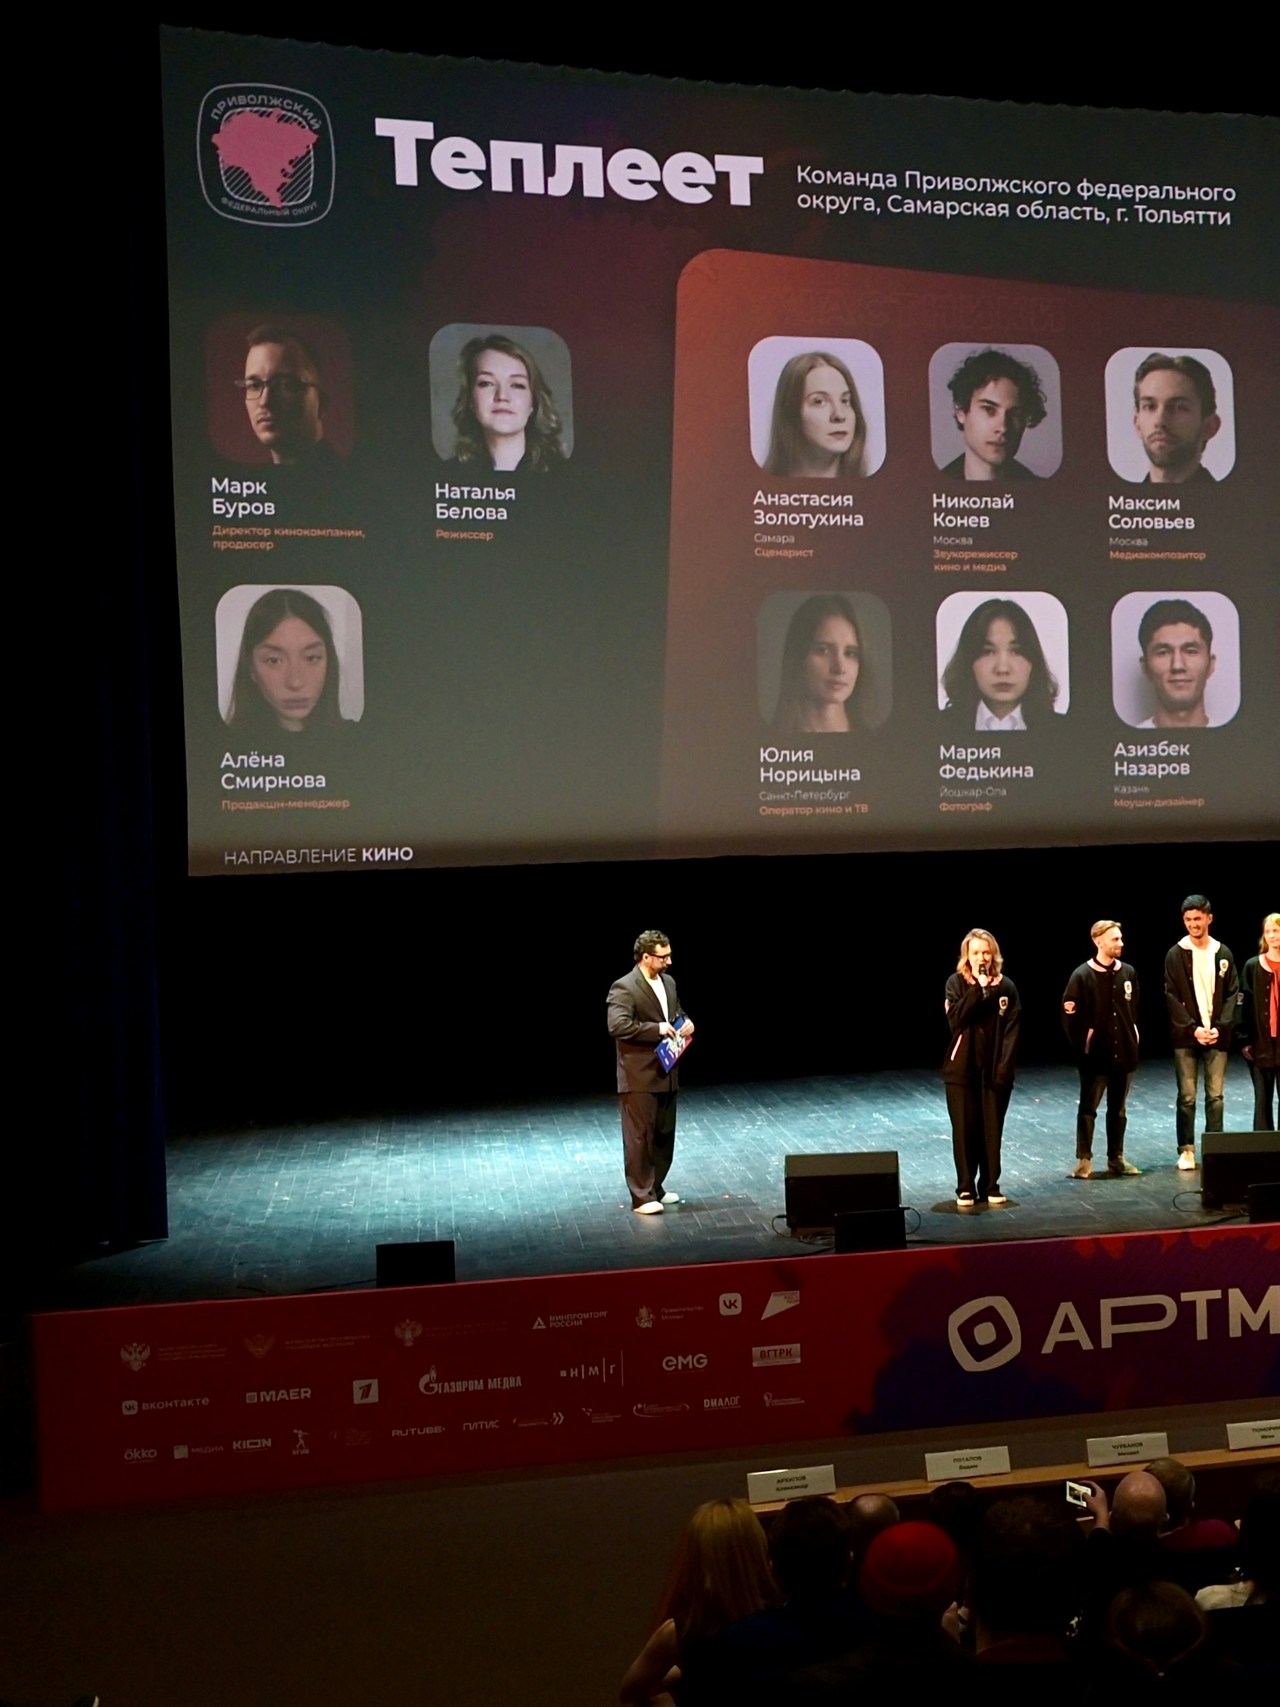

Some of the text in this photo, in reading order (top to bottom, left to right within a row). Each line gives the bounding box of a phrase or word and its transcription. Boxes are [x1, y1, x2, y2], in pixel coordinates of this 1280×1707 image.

[211, 94, 321, 130] ПРИВОЛЖСКИЙ
[375, 117, 764, 206] Теплеет
[797, 166, 1236, 202] Команда Приволжского федерального
[221, 196, 318, 216] ФЕДЕРАЛЬНЫЙ ОКРУГ
[797, 192, 1231, 226] округа, Самарская область, г. Тольятти
[211, 478, 267, 497] Марк
[435, 483, 516, 501] Наталья
[753, 490, 854, 507] Анастасия
[932, 493, 1015, 509] Николай
[1108, 495, 1181, 511] Максим
[212, 498, 276, 518] Буров
[436, 503, 508, 520] Белова
[754, 510, 864, 529] Золотухина
[933, 513, 990, 528] Конев
[1108, 514, 1196, 530] Соловьев
[212, 525, 366, 540] Директор кинокомпании,
[436, 529, 494, 542] Режиссер
[754, 533, 795, 545] Самара
[933, 535, 973, 546] Москва
[213, 539, 274, 552] продюсер
[1109, 537, 1149, 547] Москва
[754, 547, 814, 559] Сценарист
[933, 549, 1018, 561] Звукорежиссер
[1109, 550, 1207, 561] Медиакомпозитор
[934, 563, 960, 571] кино
[973, 562, 1007, 573] медиа
[760, 748, 813, 763] Юлия
[940, 745, 1001, 762] Мария
[1114, 741, 1190, 757] Азизбек
[220, 751, 285, 769] Алёна
[760, 767, 861, 785] Норицына
[940, 764, 1034, 781] Федькина
[1114, 760, 1190, 778] Назаров
[221, 773, 326, 792] Смирнова
[1114, 784, 1150, 794] Казань
[759, 790, 850, 802] Санкт-Петербург
[760, 805, 813, 817] Оператор
[815, 805, 842, 814] кино
[855, 804, 868, 813] ТВ
[940, 801, 992, 813] Фотограф
[224, 847, 413, 865] НАПРАВЛЕНИЕ КИНО
[723, 1300, 738, 1309] VK
[550, 1311, 608, 1322] МИНПРОМТОРГ
[550, 1320, 583, 1329] РОССИИ
[760, 1348, 792, 1359] ВГТРК
[438, 1376, 522, 1395] ГАЗПРОМ МЕДИА
[260, 1387, 312, 1402] MAER
[392, 1426, 443, 1437] RUTUBE
